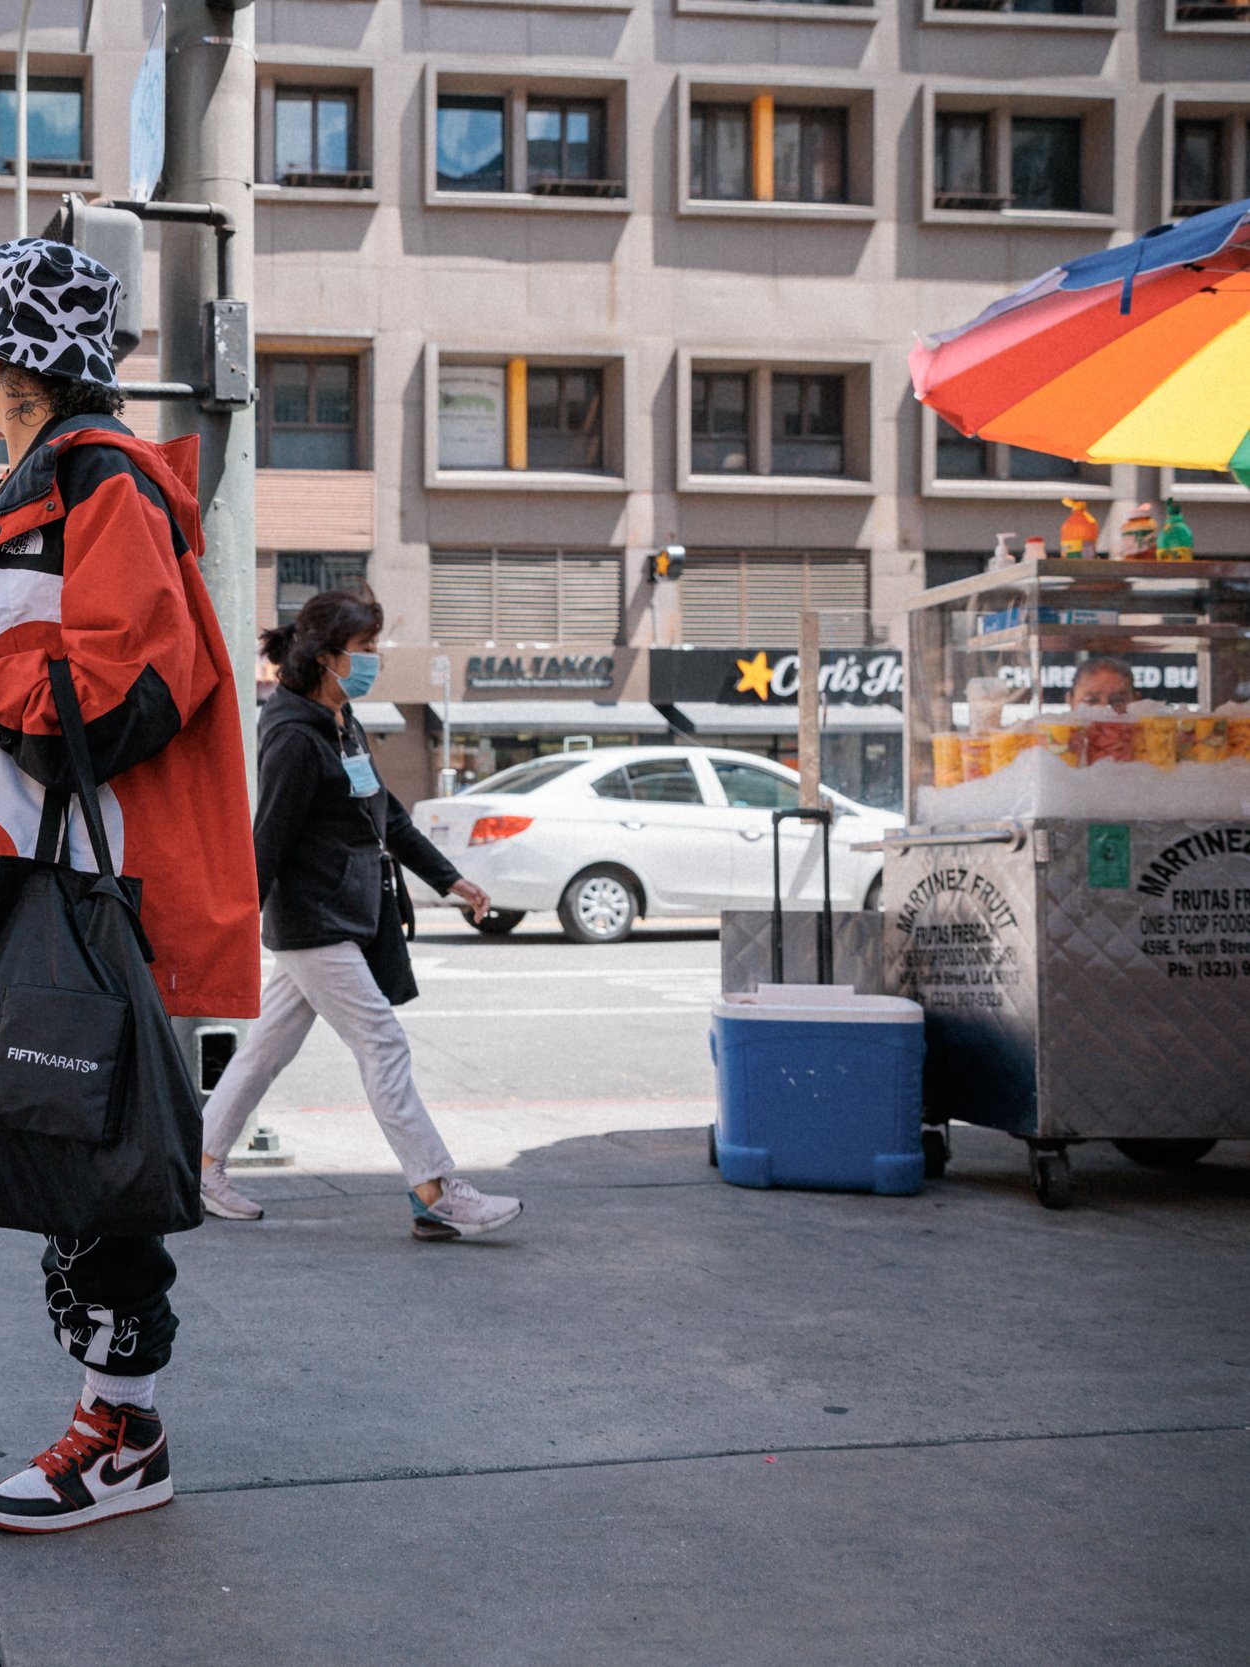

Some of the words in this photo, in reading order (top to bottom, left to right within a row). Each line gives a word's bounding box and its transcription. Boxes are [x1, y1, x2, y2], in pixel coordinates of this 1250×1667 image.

[1, 543, 28, 555] FACE
[468, 656, 524, 677] REAL
[771, 655, 862, 696] Crl's
[897, 869, 968, 934] MARTINEZ
[971, 875, 1018, 929] FRUIT
[1173, 889, 1230, 911] FRUTAS
[1140, 916, 1165, 935] ONE
[1178, 940, 1217, 955] Fourth
[1168, 962, 1192, 977] Ph:
[1198, 960, 1238, 980] (323)
